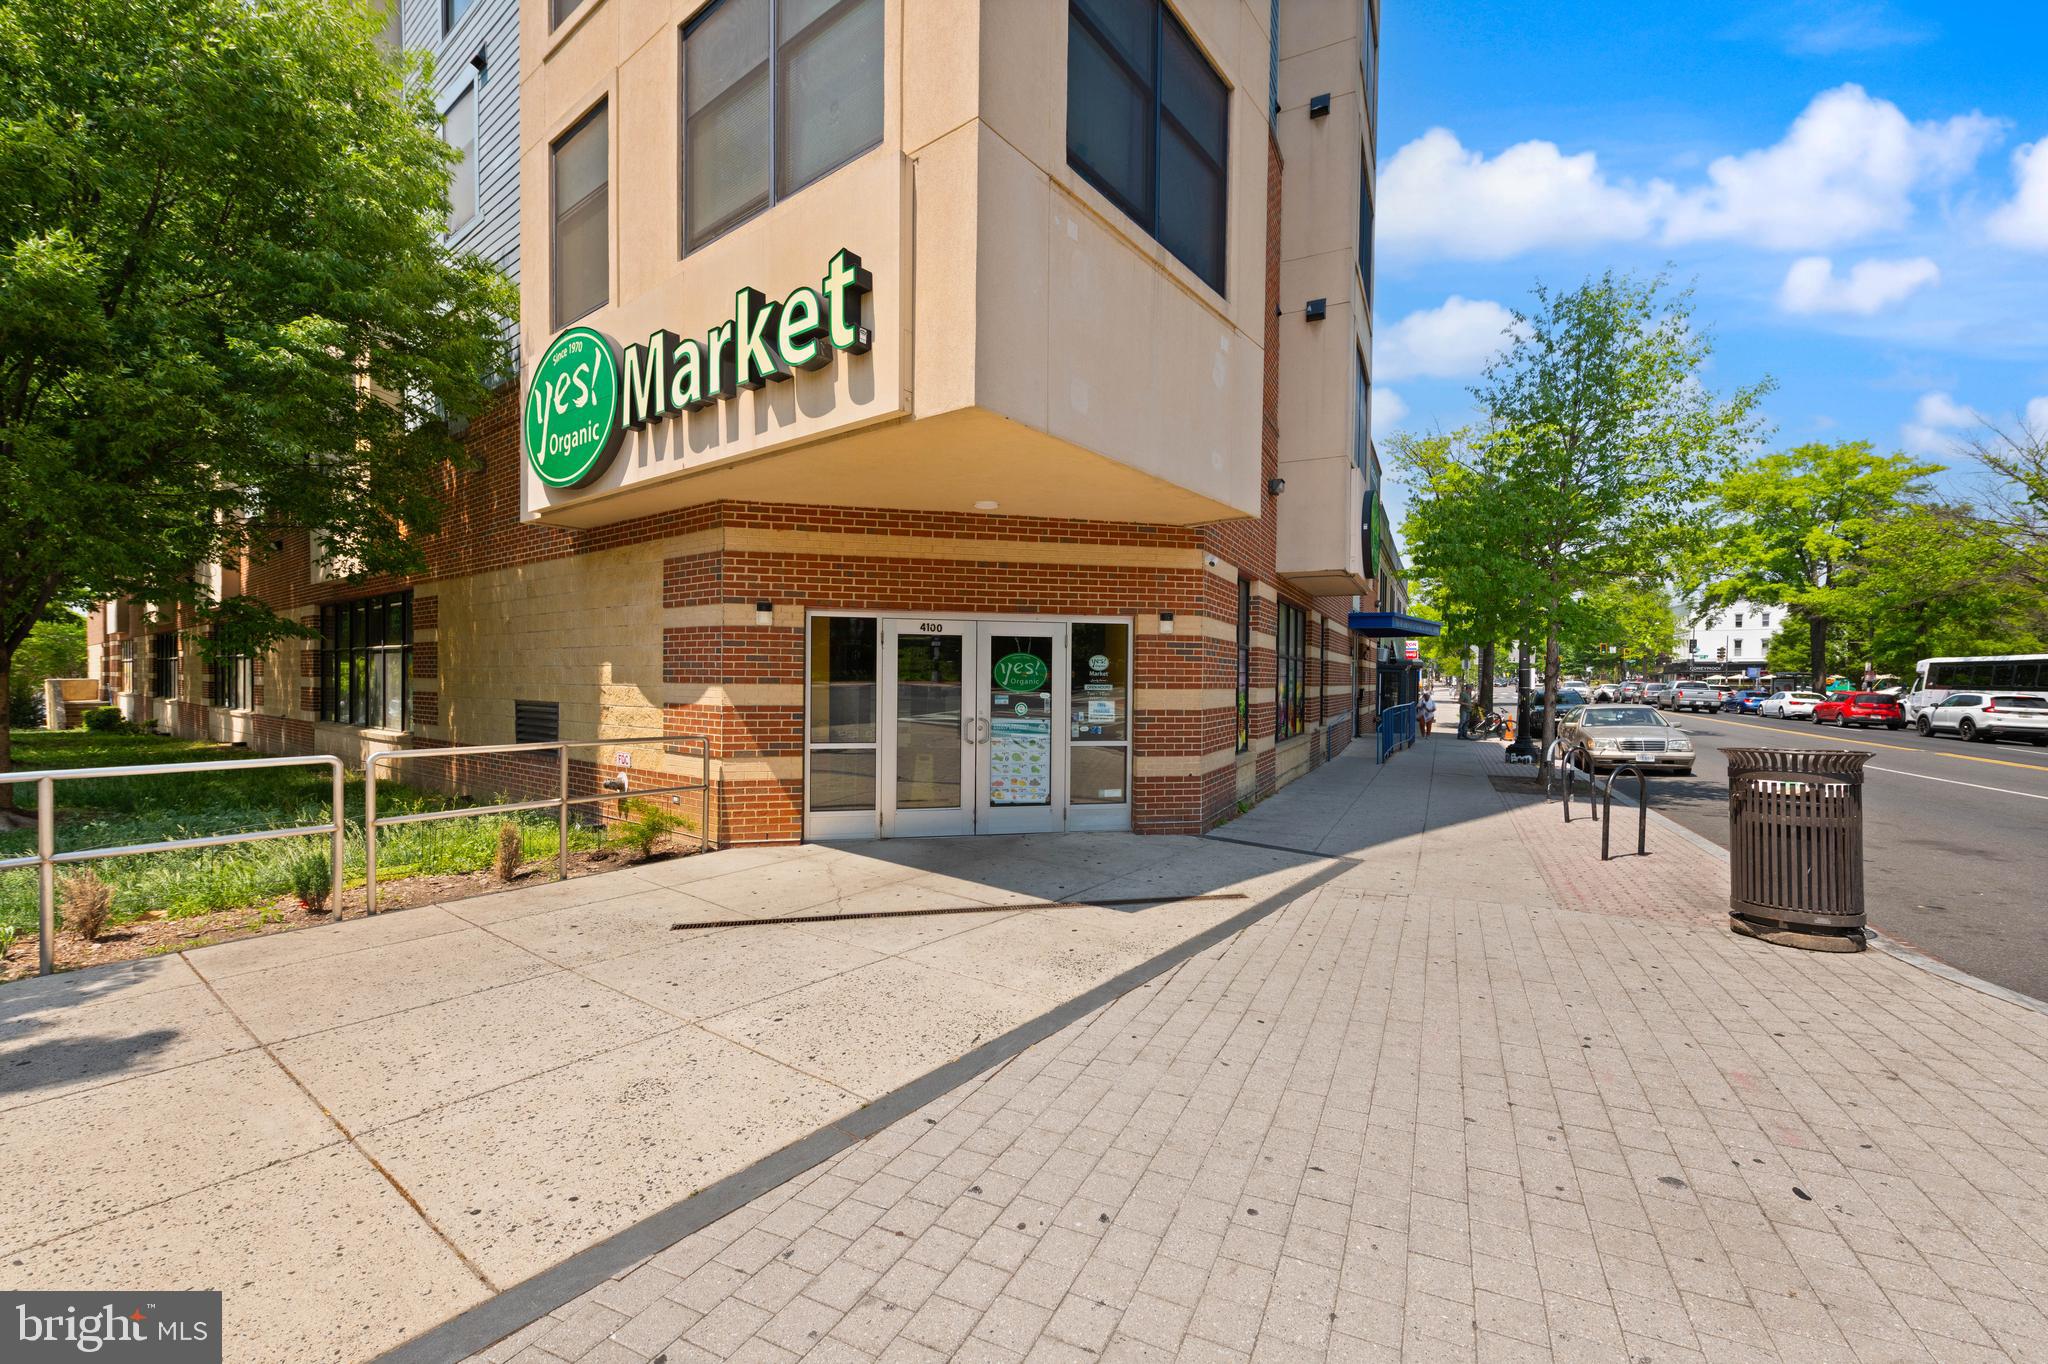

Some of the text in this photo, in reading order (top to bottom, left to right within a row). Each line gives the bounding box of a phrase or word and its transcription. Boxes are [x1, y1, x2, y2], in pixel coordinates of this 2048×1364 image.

[552, 341, 583, 366] Since 1970
[622, 248, 857, 429] Market
[535, 347, 601, 465] yes!
[549, 420, 599, 456] Organic
[920, 622, 943, 633] 4100
[1001, 661, 1040, 685] yes!
